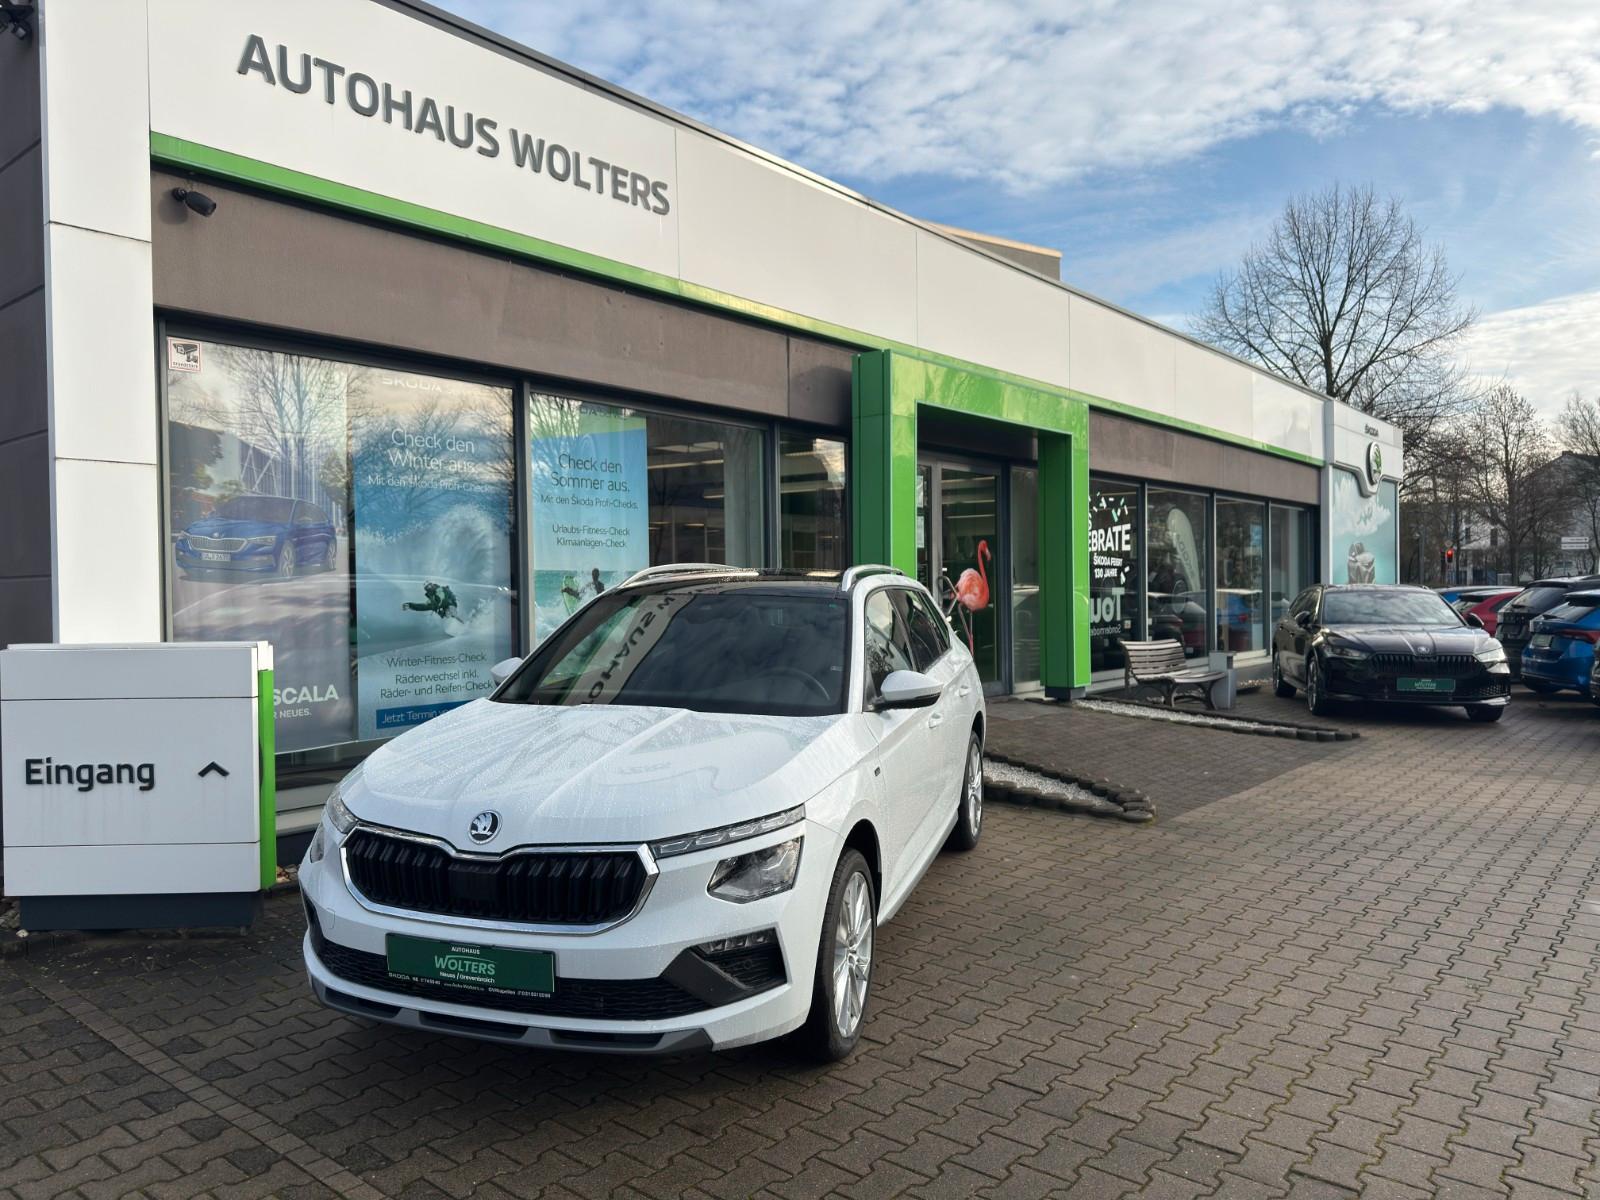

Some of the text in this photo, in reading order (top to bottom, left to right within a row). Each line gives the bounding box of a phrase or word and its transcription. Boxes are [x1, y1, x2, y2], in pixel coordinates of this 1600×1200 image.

[237, 33, 671, 216] AUTOHAUS WOLTERS
[391, 428, 475, 453] Check den
[387, 448, 443, 470] Winter
[558, 453, 623, 474] Check den
[367, 474, 385, 486] Mit
[387, 476, 406, 488] den
[551, 471, 631, 492] Sommer aus.
[540, 493, 553, 504] Mit
[555, 495, 570, 505] den
[571, 493, 594, 507] Škoda
[552, 523, 630, 536] Urlaubs-Fitness-Check
[556, 536, 626, 549] Klimaanlagen-Check
[1094, 568, 1103, 578] 130
[387, 652, 487, 668] Winter-Fitness-Check
[395, 669, 479, 685] Räderwechsel inkl.
[380, 680, 494, 699] Räder- und Reifen-Check
[382, 711, 404, 724] Jetzt
[406, 709, 437, 721] Termin
[25, 757, 155, 792] Eingang
[451, 946, 480, 955] AUTOHAUS
[434, 954, 496, 975] WOLTERS
